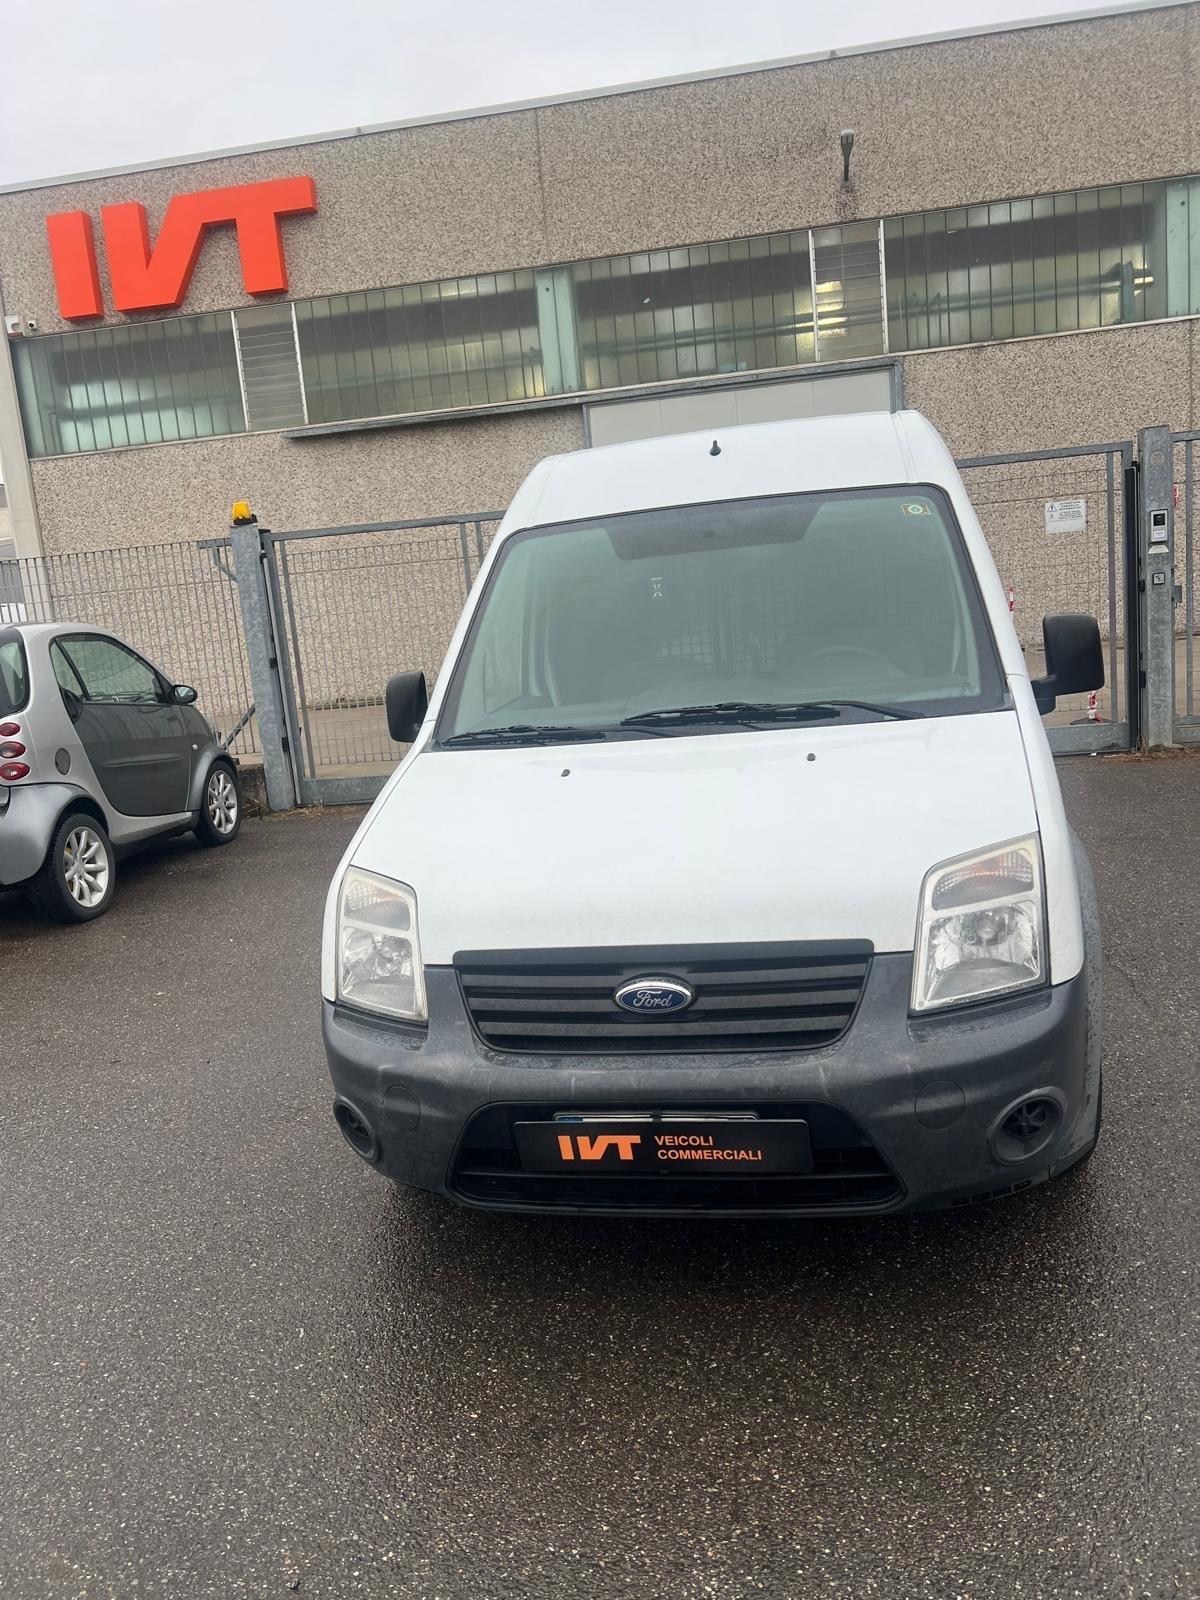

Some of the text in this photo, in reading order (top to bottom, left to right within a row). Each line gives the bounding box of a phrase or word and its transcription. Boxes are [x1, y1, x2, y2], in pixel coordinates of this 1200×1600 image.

[46, 175, 318, 321] IVT
[632, 989, 673, 1007] Ford
[557, 1135, 641, 1161] IVT
[654, 1135, 714, 1147] VEICOLI
[657, 1149, 763, 1161] COMMERCIALI
